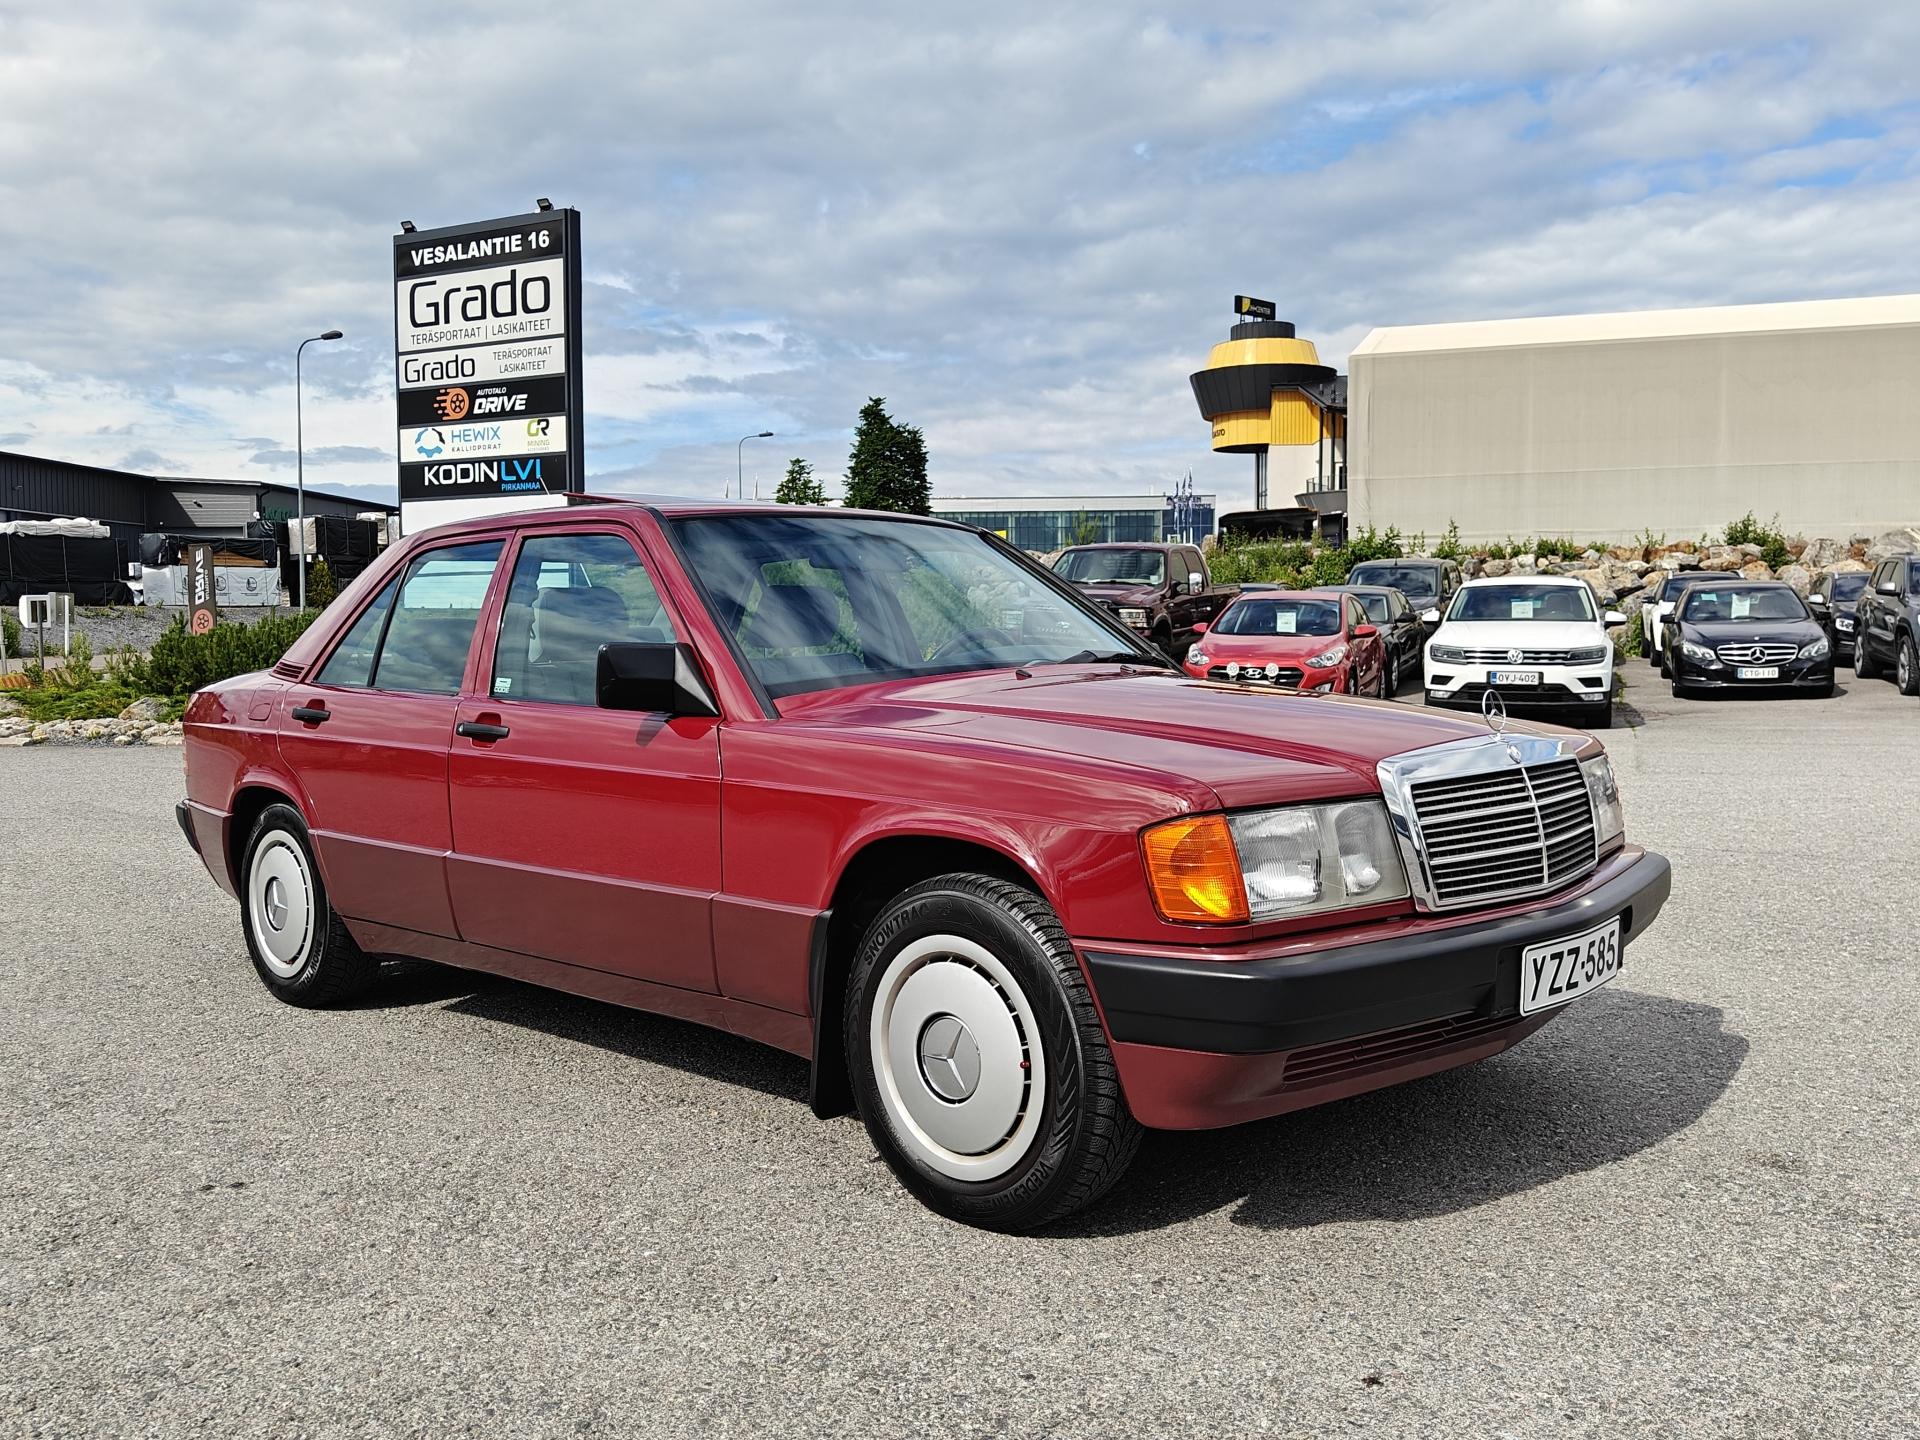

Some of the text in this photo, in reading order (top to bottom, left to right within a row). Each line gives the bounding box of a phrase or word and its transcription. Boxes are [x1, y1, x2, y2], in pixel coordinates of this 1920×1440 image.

[411, 230, 550, 267] VESALANTIE 16
[409, 269, 551, 328] Grado
[411, 318, 552, 345] TERÄSPORTAAT LASIKAITEET
[493, 346, 553, 361] TERÄSPORTAAT
[404, 354, 476, 383] Grado
[499, 360, 547, 374] LASIKAITEET
[476, 387, 507, 396] AUTOTALO
[473, 394, 528, 414] DRIVE
[451, 426, 501, 443] HEWIX
[451, 443, 502, 452] KALLIOPORAT
[501, 482, 541, 492] PIRKANMAA
[1498, 674, 1537, 683] OVJ-402
[1530, 930, 1616, 1001] YZZ-585
